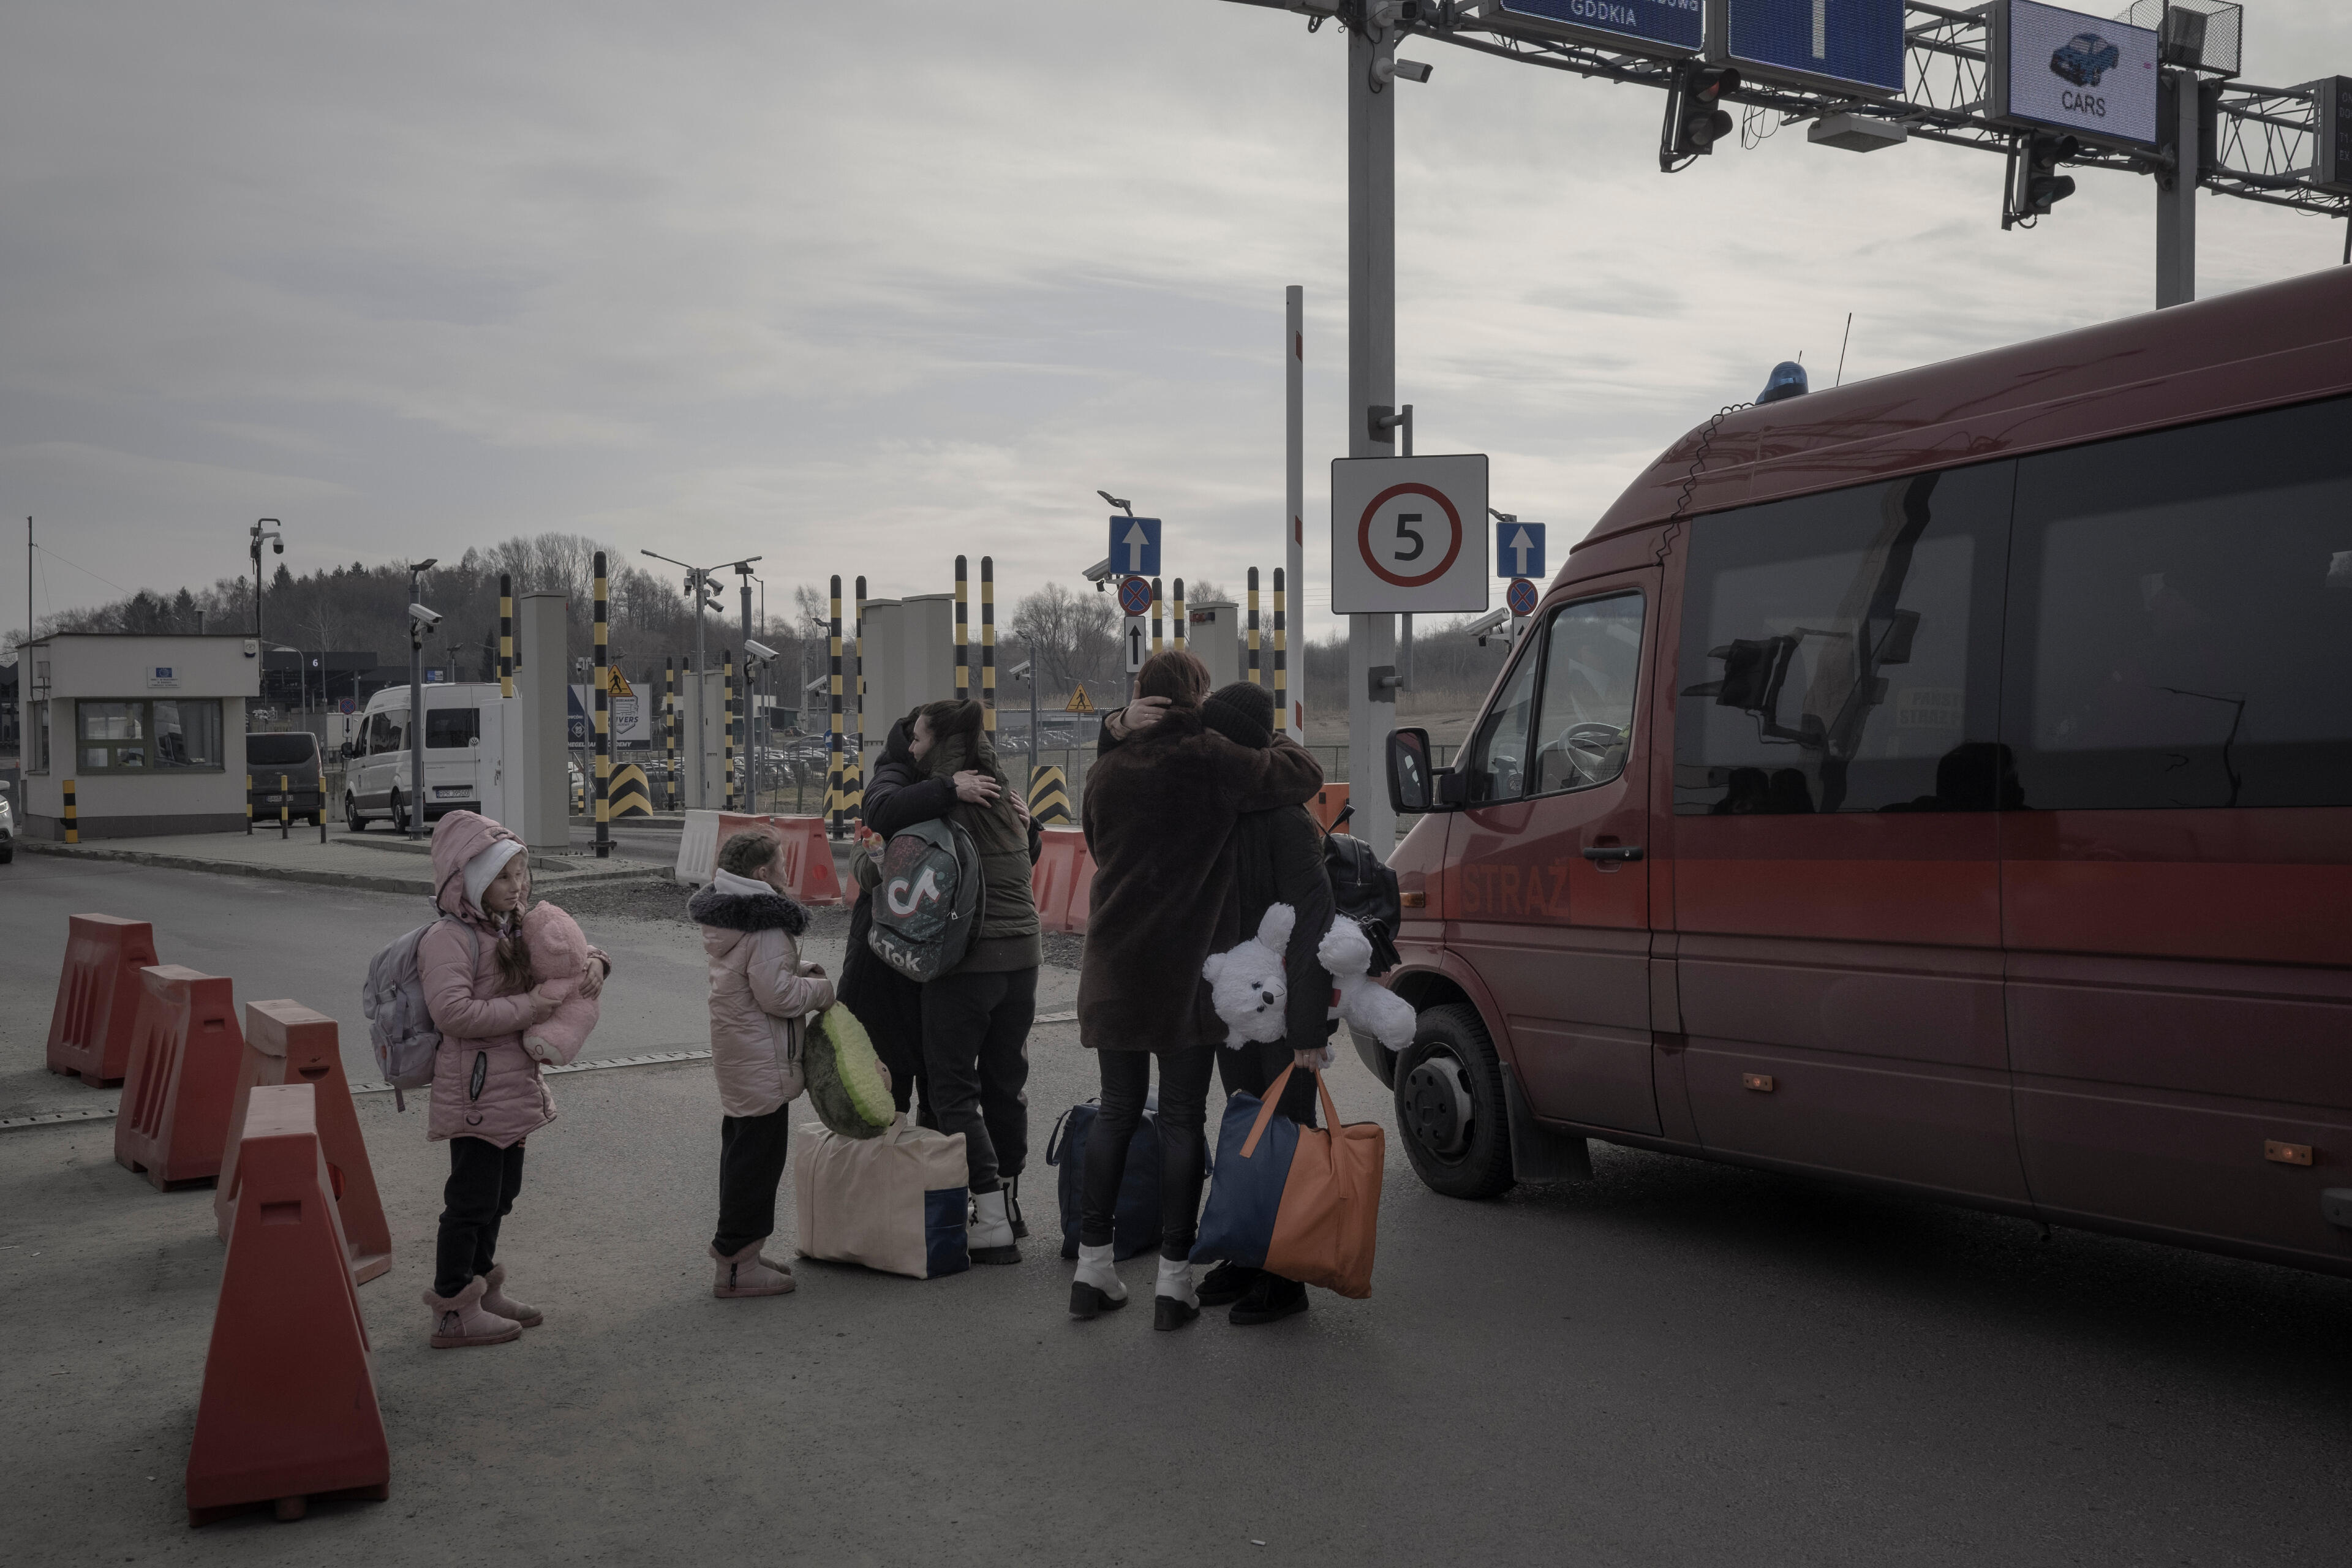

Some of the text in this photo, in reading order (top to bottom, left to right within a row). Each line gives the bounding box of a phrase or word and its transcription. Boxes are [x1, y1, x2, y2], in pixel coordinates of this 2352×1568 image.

[2062, 90, 2106, 118] CARS
[1394, 513, 1424, 561] 5
[1461, 858, 1570, 917] STRAŻ
